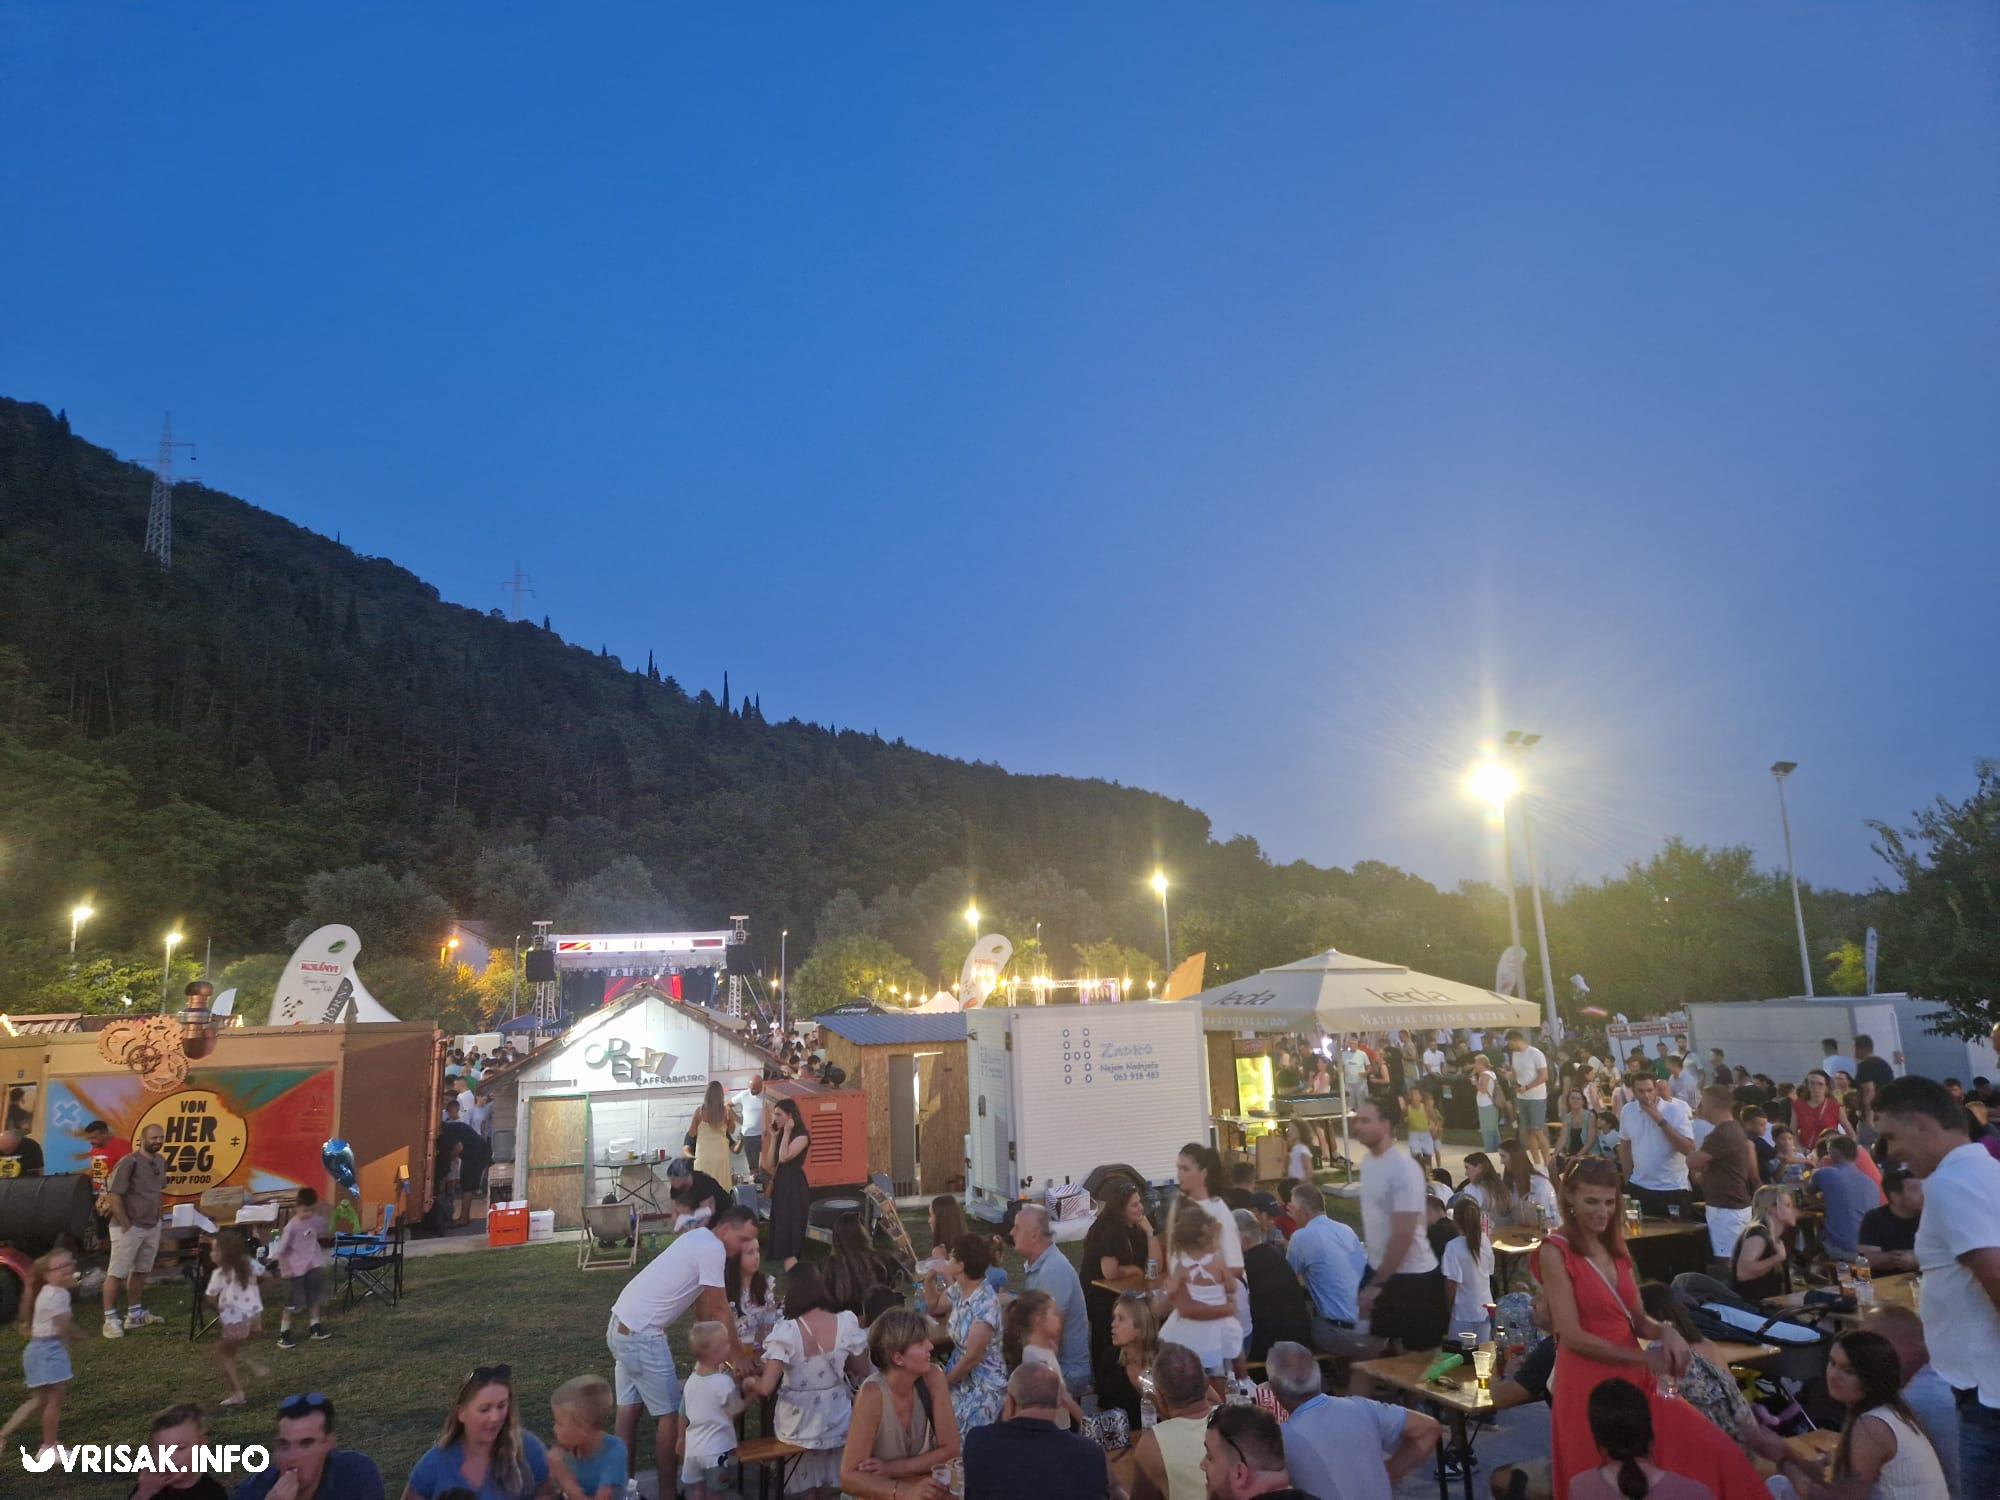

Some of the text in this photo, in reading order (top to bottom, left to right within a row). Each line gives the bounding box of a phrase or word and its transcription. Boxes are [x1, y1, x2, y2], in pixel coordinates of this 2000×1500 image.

[1364, 987, 1457, 1003] leda
[180, 1100, 207, 1113] VON
[165, 1116, 218, 1143] HER
[163, 1145, 214, 1173] ZOG
[166, 1174, 212, 1185] OPUP FOOD
